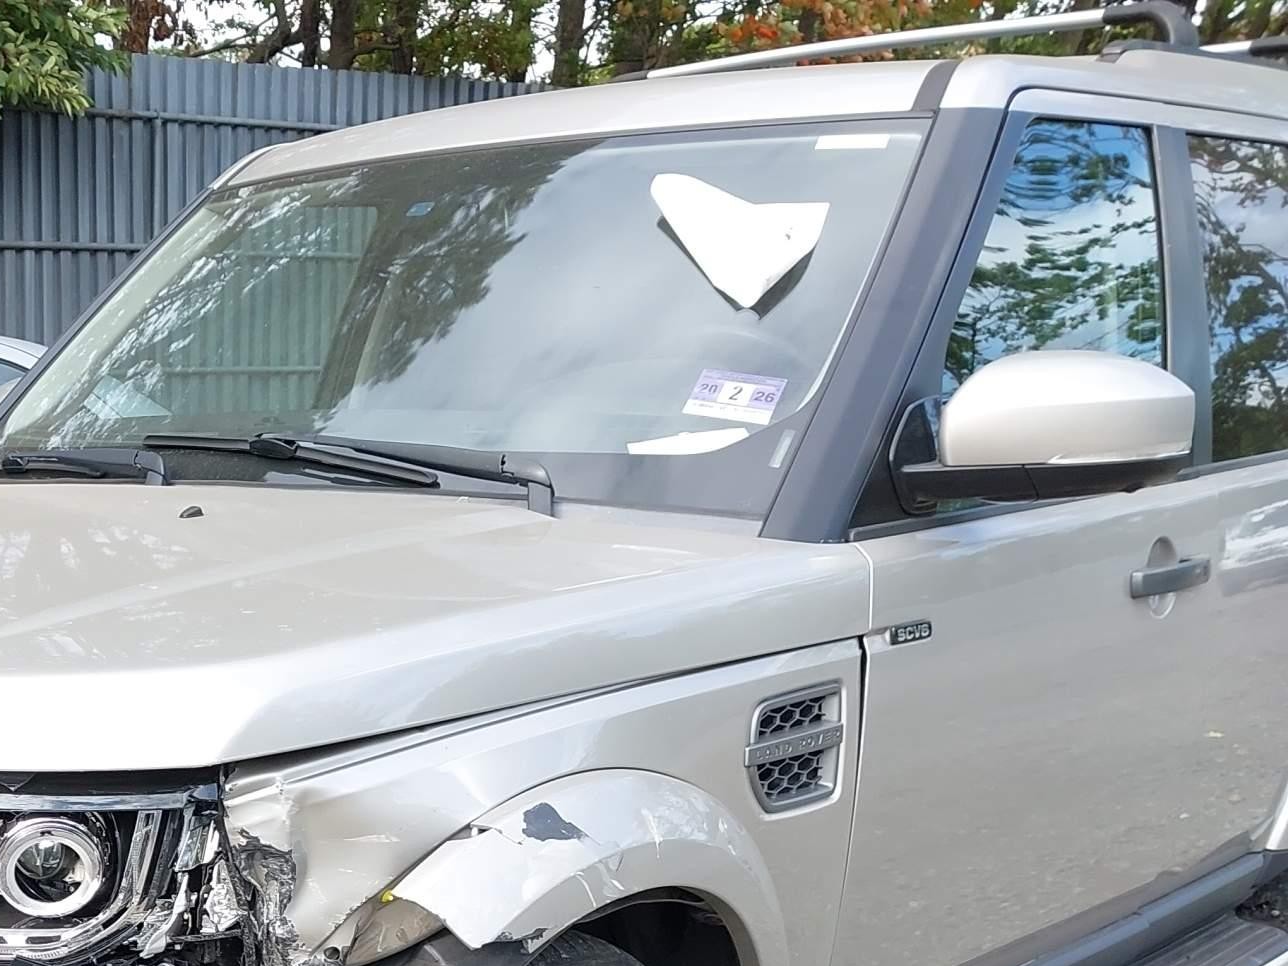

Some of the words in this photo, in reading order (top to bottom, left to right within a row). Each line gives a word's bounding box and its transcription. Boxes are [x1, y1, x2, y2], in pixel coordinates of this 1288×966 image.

[699, 382, 719, 394] 20
[728, 385, 744, 401] 2
[753, 391, 776, 403] 26
